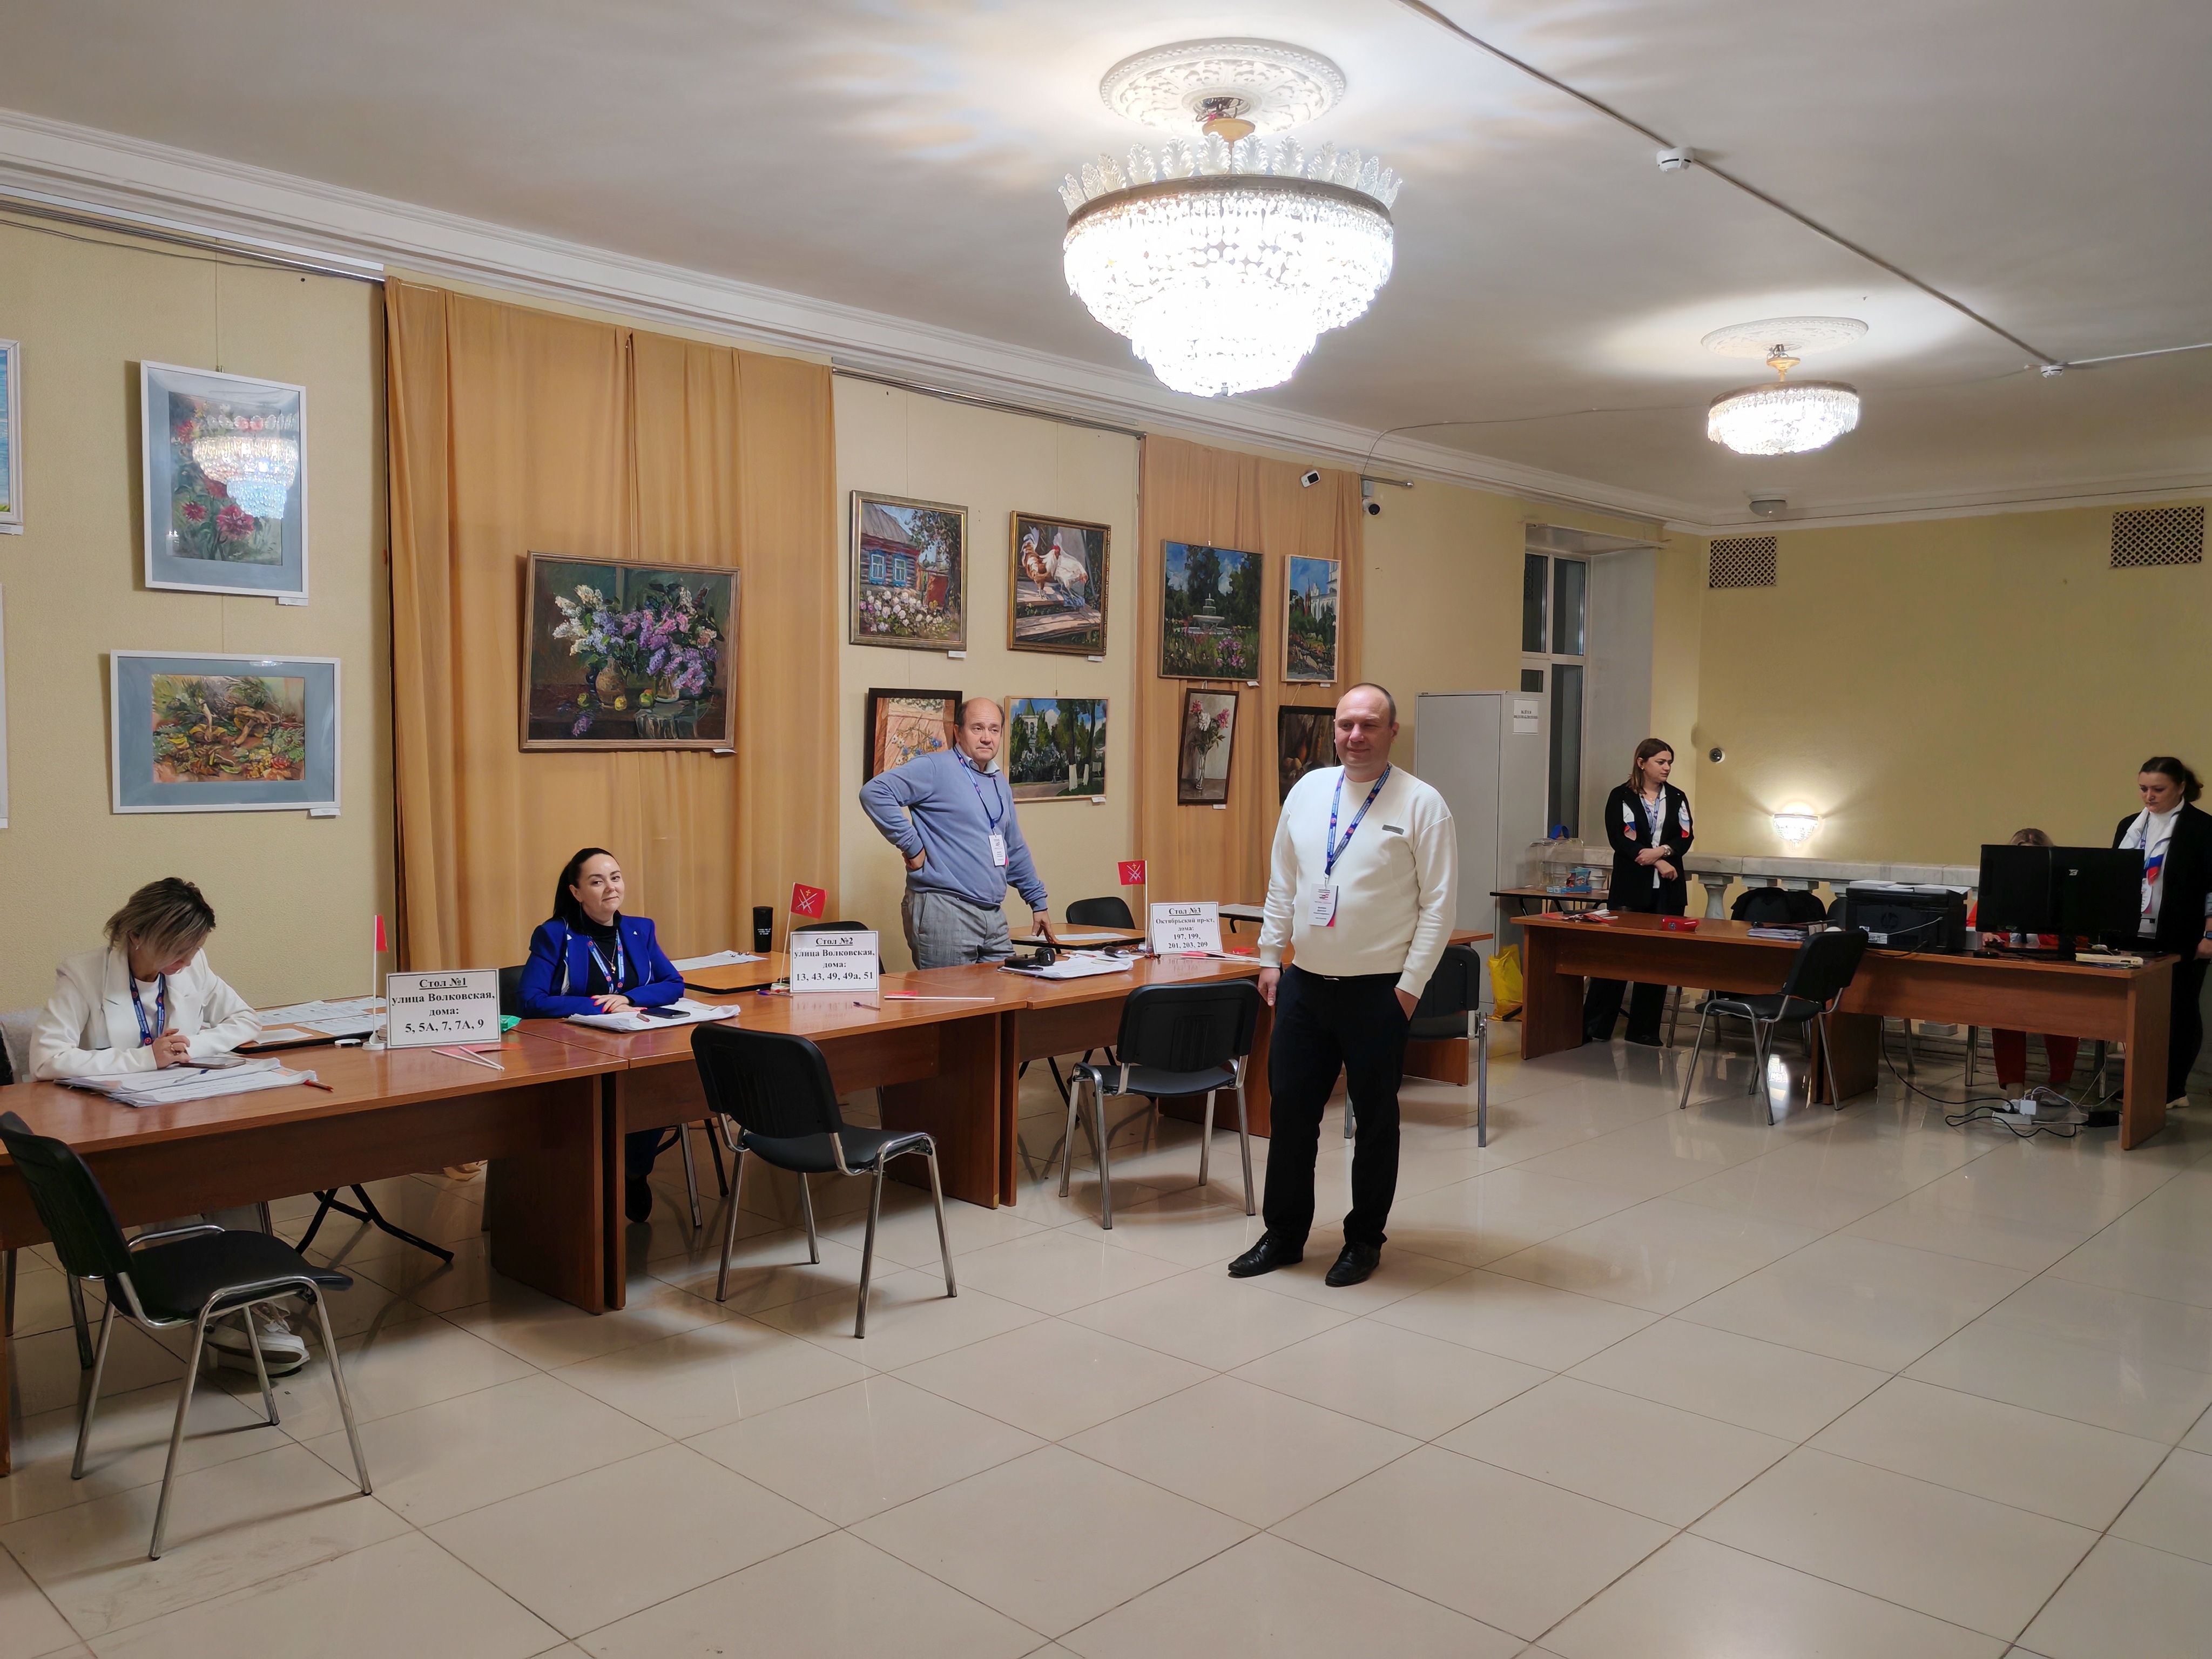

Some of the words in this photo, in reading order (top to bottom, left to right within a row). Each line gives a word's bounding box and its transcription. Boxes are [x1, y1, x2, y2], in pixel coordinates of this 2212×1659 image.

[419, 979, 446, 988] Стол
[449, 977, 466, 987] №1
[796, 974, 809, 982] 13,
[811, 973, 824, 981] 43,
[827, 973, 840, 981] 49,
[843, 972, 861, 981] 49а,
[864, 972, 873, 980] 51
[392, 995, 424, 1006] улица
[428, 991, 495, 1002] Волковская,
[429, 1008, 459, 1016] дома:
[405, 1023, 415, 1034] 5,
[419, 1022, 438, 1033] 5А,
[442, 1021, 451, 1031] 7,
[455, 1020, 474, 1030] 7А,
[478, 1019, 484, 1028] 9
